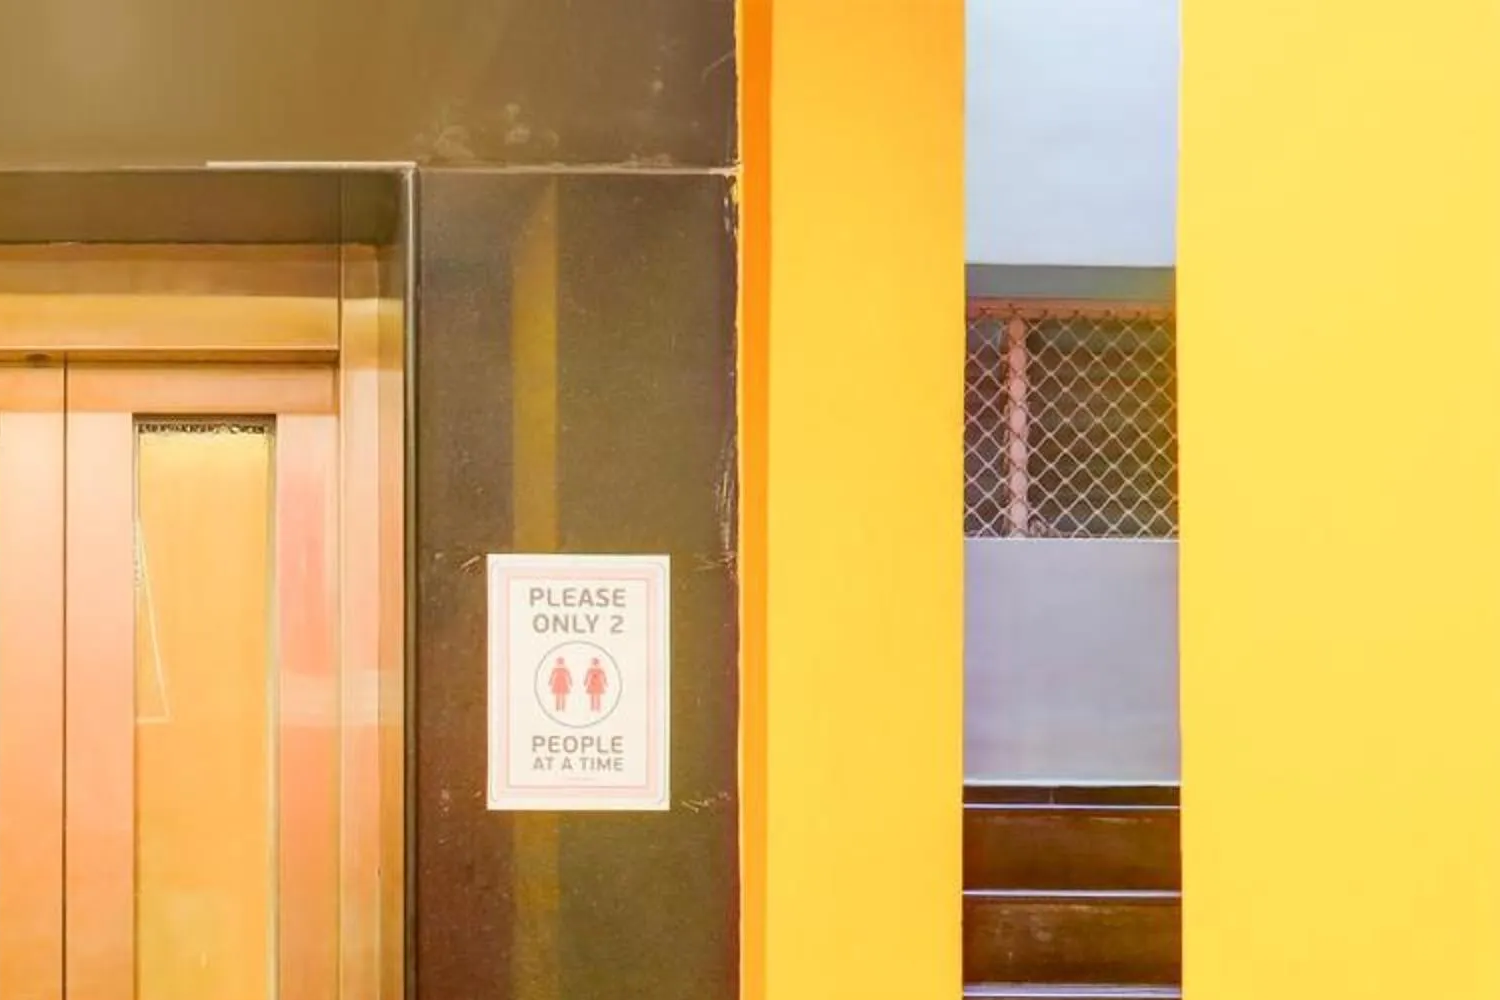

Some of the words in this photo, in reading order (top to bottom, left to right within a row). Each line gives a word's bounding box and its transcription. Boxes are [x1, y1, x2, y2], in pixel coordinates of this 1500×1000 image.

[529, 587, 626, 607] PLEASE
[532, 613, 600, 634] ONLY
[610, 615, 625, 634] 2
[532, 735, 624, 754] PEOPLE
[533, 757, 555, 771] AT
[561, 757, 574, 771] A
[580, 757, 624, 772] TIME
